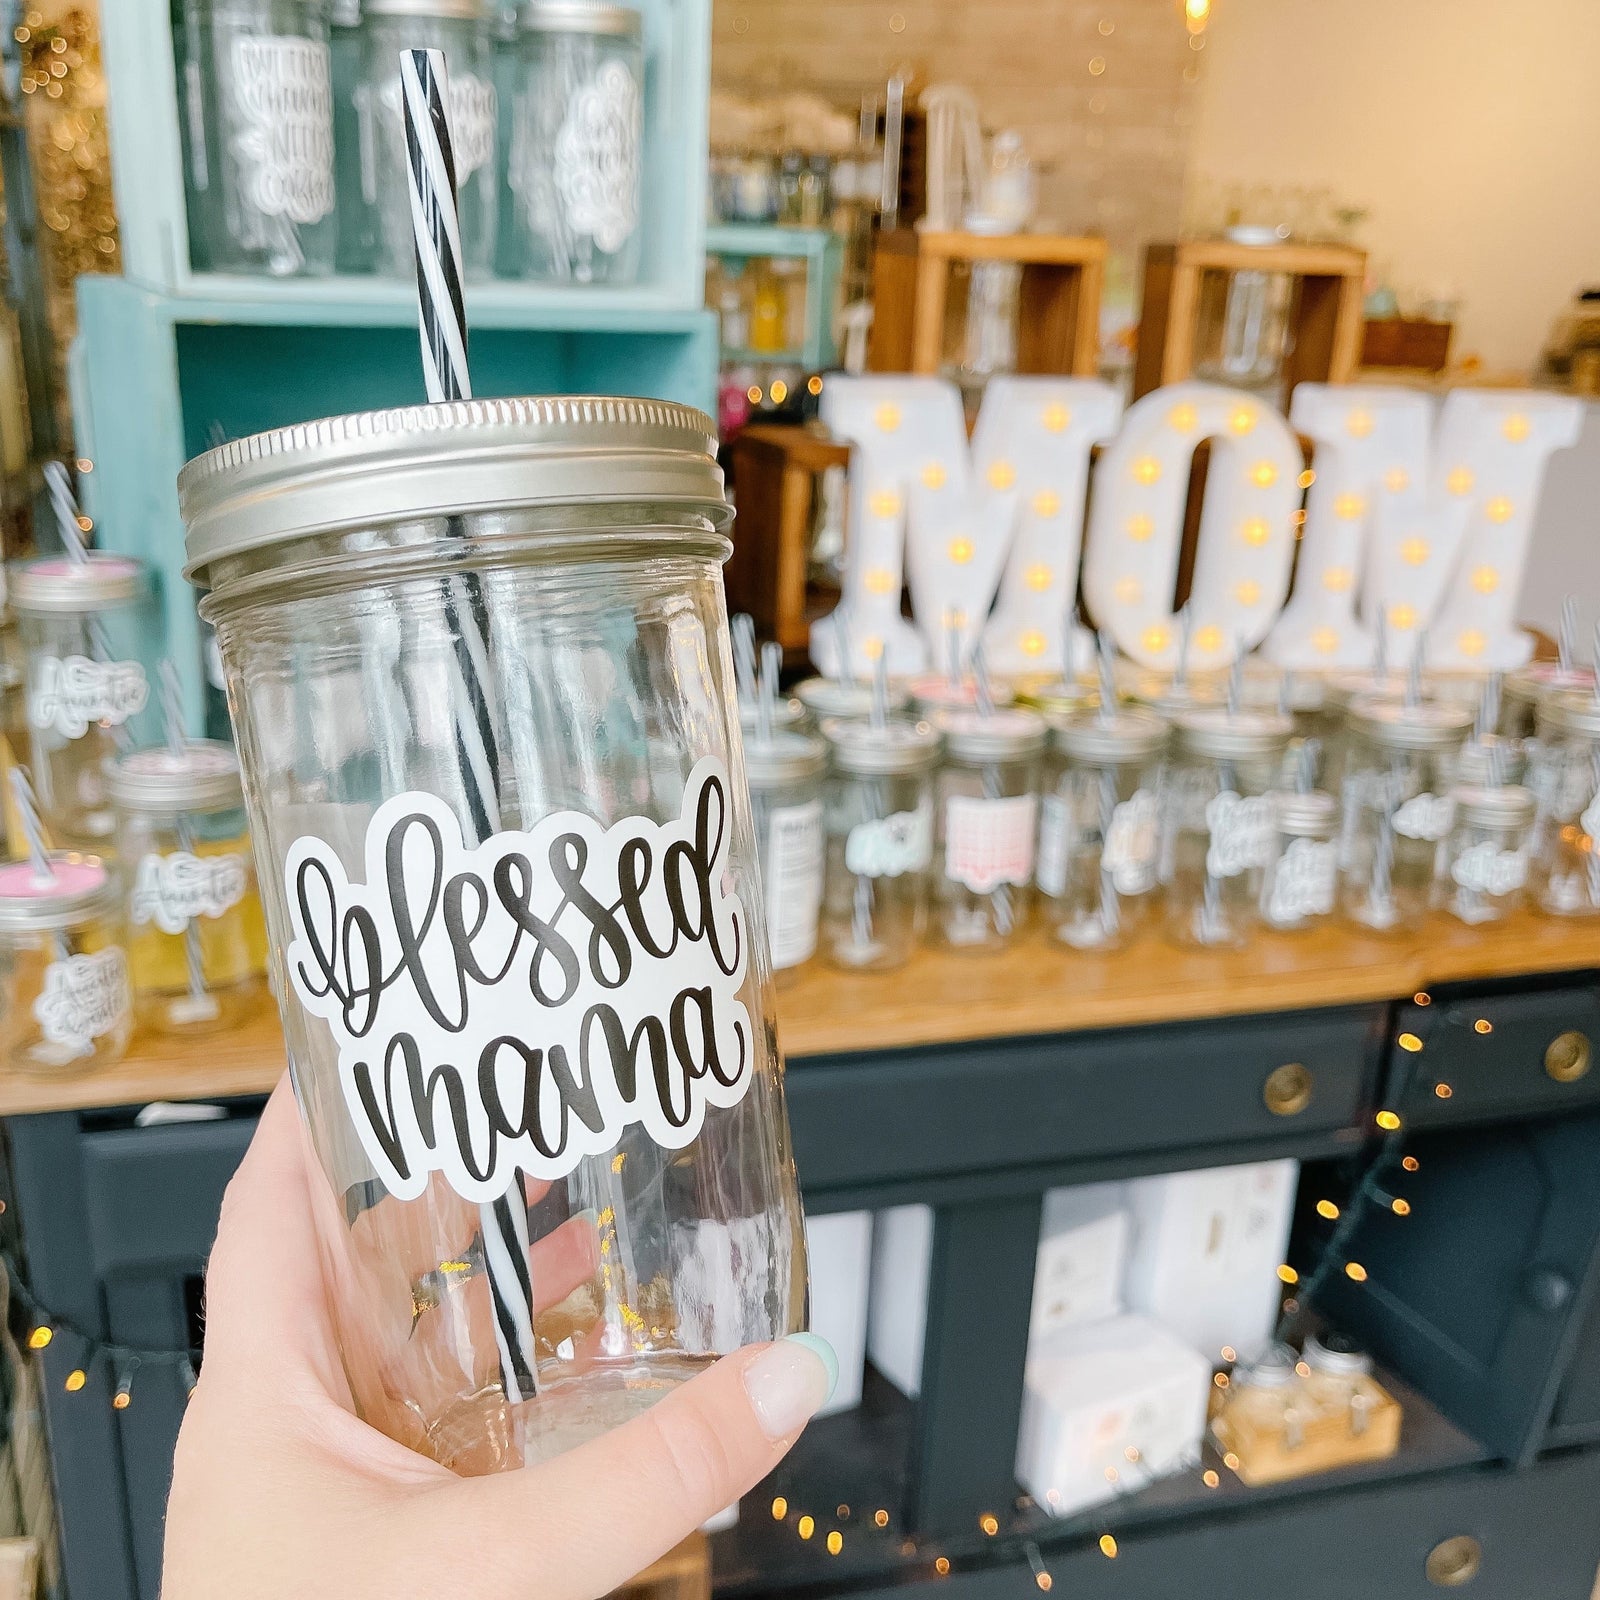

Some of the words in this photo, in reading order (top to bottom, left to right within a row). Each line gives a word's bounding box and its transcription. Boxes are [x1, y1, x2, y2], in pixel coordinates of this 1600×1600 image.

[811, 375, 1581, 675] MOM
[297, 776, 740, 1037] blessed
[354, 987, 744, 1182] mama
